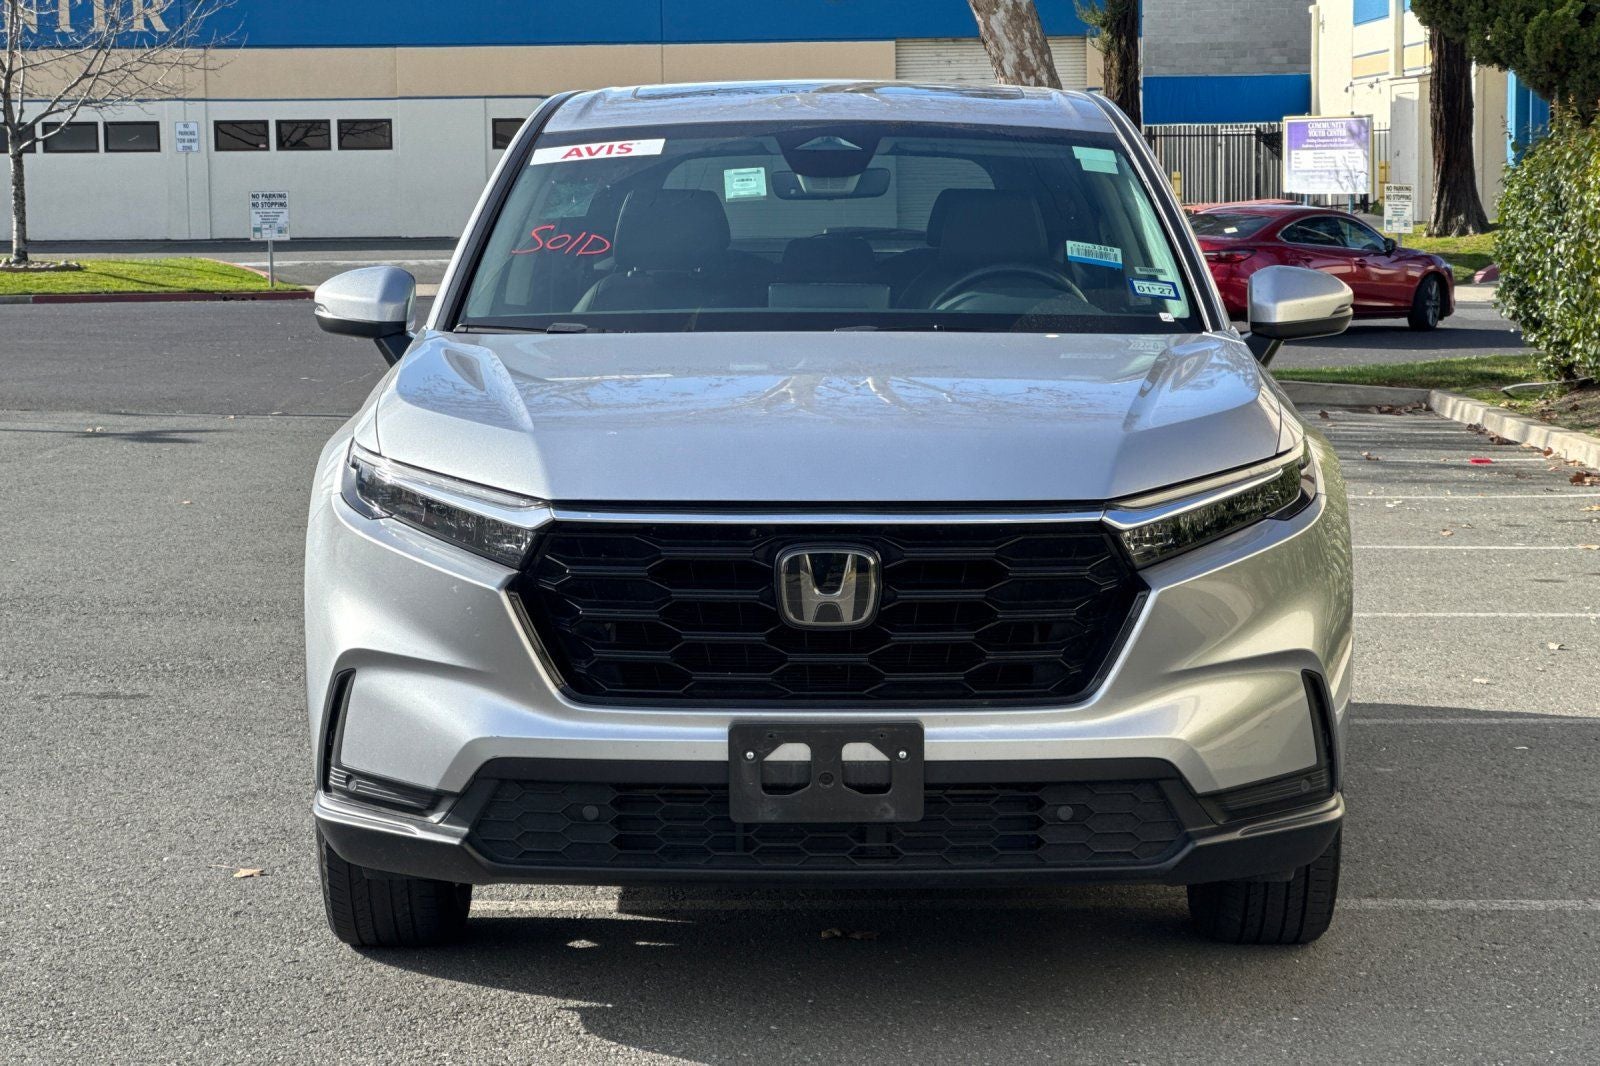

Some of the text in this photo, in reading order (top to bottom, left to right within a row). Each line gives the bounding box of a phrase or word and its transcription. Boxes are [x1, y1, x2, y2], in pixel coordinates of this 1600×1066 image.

[1308, 129, 1347, 137] YOUTH CENTER
[560, 142, 633, 160] AVIS
